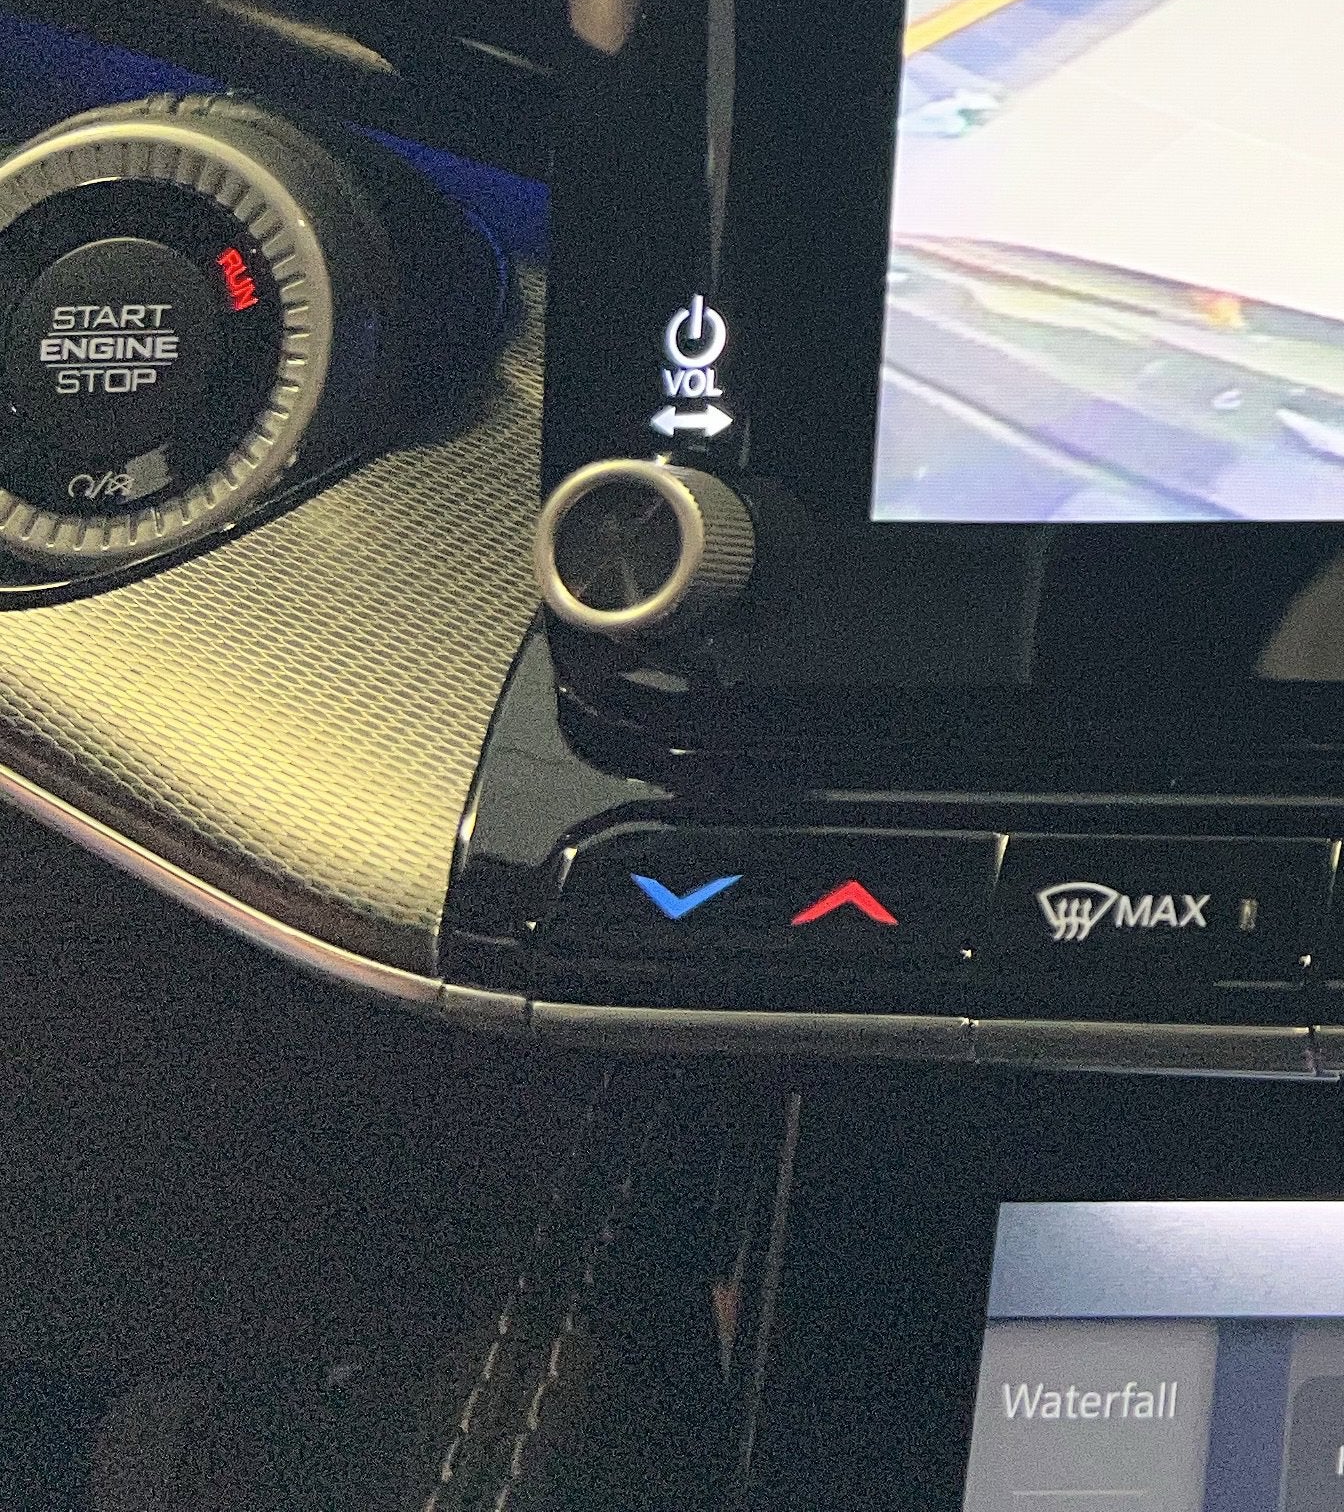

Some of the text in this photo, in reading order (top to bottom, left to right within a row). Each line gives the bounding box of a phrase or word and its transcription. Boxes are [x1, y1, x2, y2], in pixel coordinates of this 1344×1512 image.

[217, 248, 259, 311] RUN
[52, 305, 172, 330] START
[40, 337, 179, 361] ENGINE
[56, 369, 156, 394] STOP
[662, 369, 722, 397] VOL
[1115, 894, 1211, 928] MAX
[1003, 1381, 1178, 1419] Waterfall
